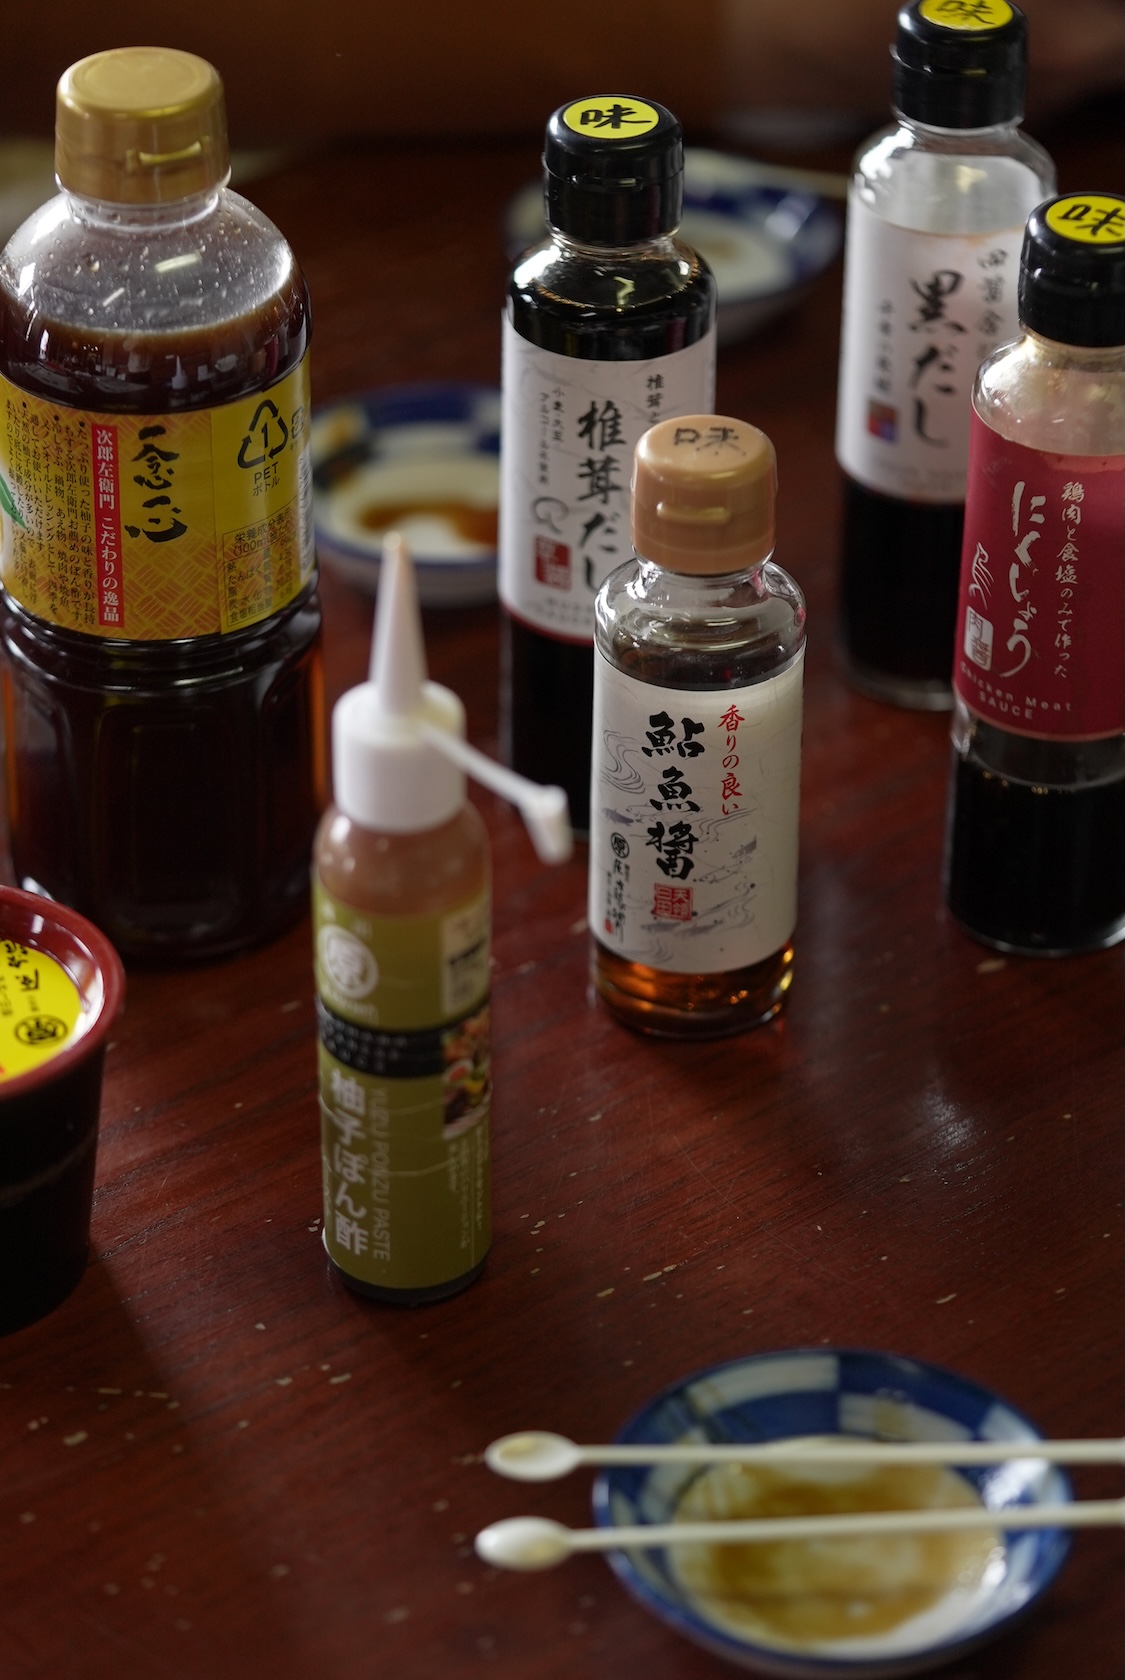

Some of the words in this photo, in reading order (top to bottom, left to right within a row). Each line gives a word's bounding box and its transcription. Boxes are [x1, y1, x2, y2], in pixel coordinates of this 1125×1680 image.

[580, 104, 653, 129] 味
[1057, 204, 1125, 236] 味
[673, 426, 747, 457] 味
[96, 429, 115, 510] 次郎左衛門
[252, 475, 280, 497] ボトル
[254, 461, 279, 484] PET
[101, 517, 119, 622] こだわりの逸品
[1054, 481, 1085, 679] 鶏肉と食塩のみで作った
[960, 661, 1014, 703] Chicken
[1025, 696, 1072, 712] Meat
[979, 691, 1034, 719] SAUCE
[717, 704, 746, 816] 香りの良い
[372, 1206, 391, 1262] PASTE
